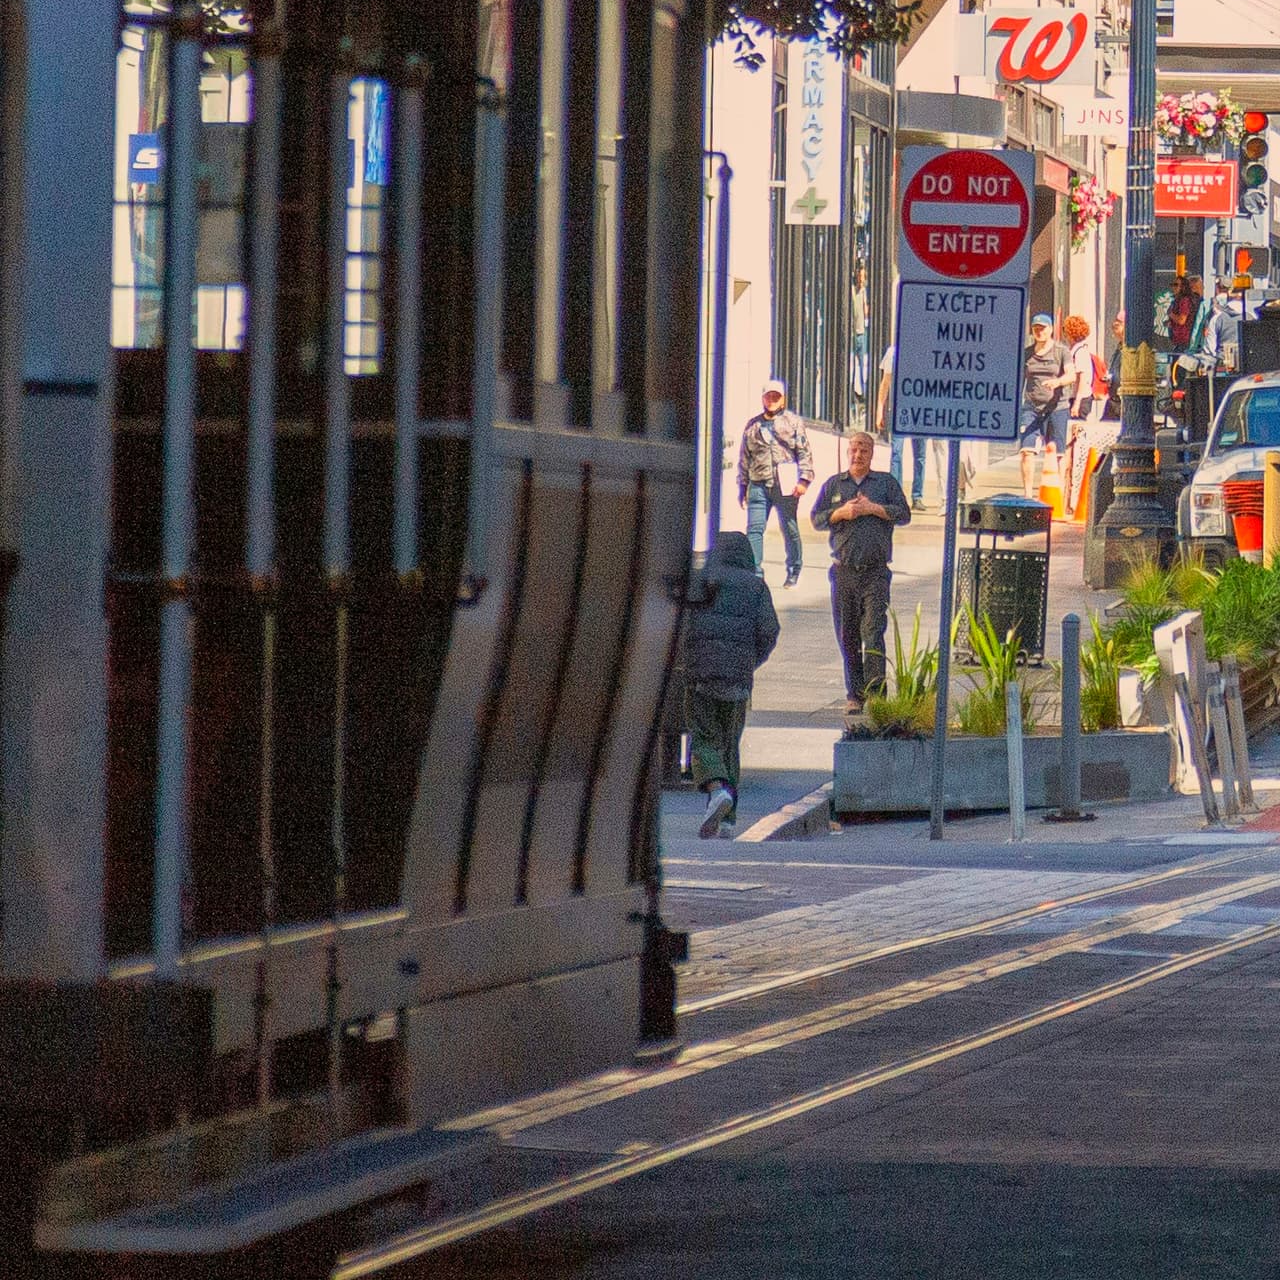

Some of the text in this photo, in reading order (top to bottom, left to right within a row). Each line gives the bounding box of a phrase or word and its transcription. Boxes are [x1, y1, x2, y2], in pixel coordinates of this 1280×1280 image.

[922, 174, 1012, 197] DO NOT
[1167, 185, 1207, 194] HOTEL
[928, 232, 1000, 255] ENTER
[925, 292, 998, 315] EXCEPT
[936, 321, 983, 343] MUNI
[931, 349, 986, 372] TAXIS
[901, 377, 1013, 403] COMMERCIAL
[910, 407, 1002, 431] VEHICLES
